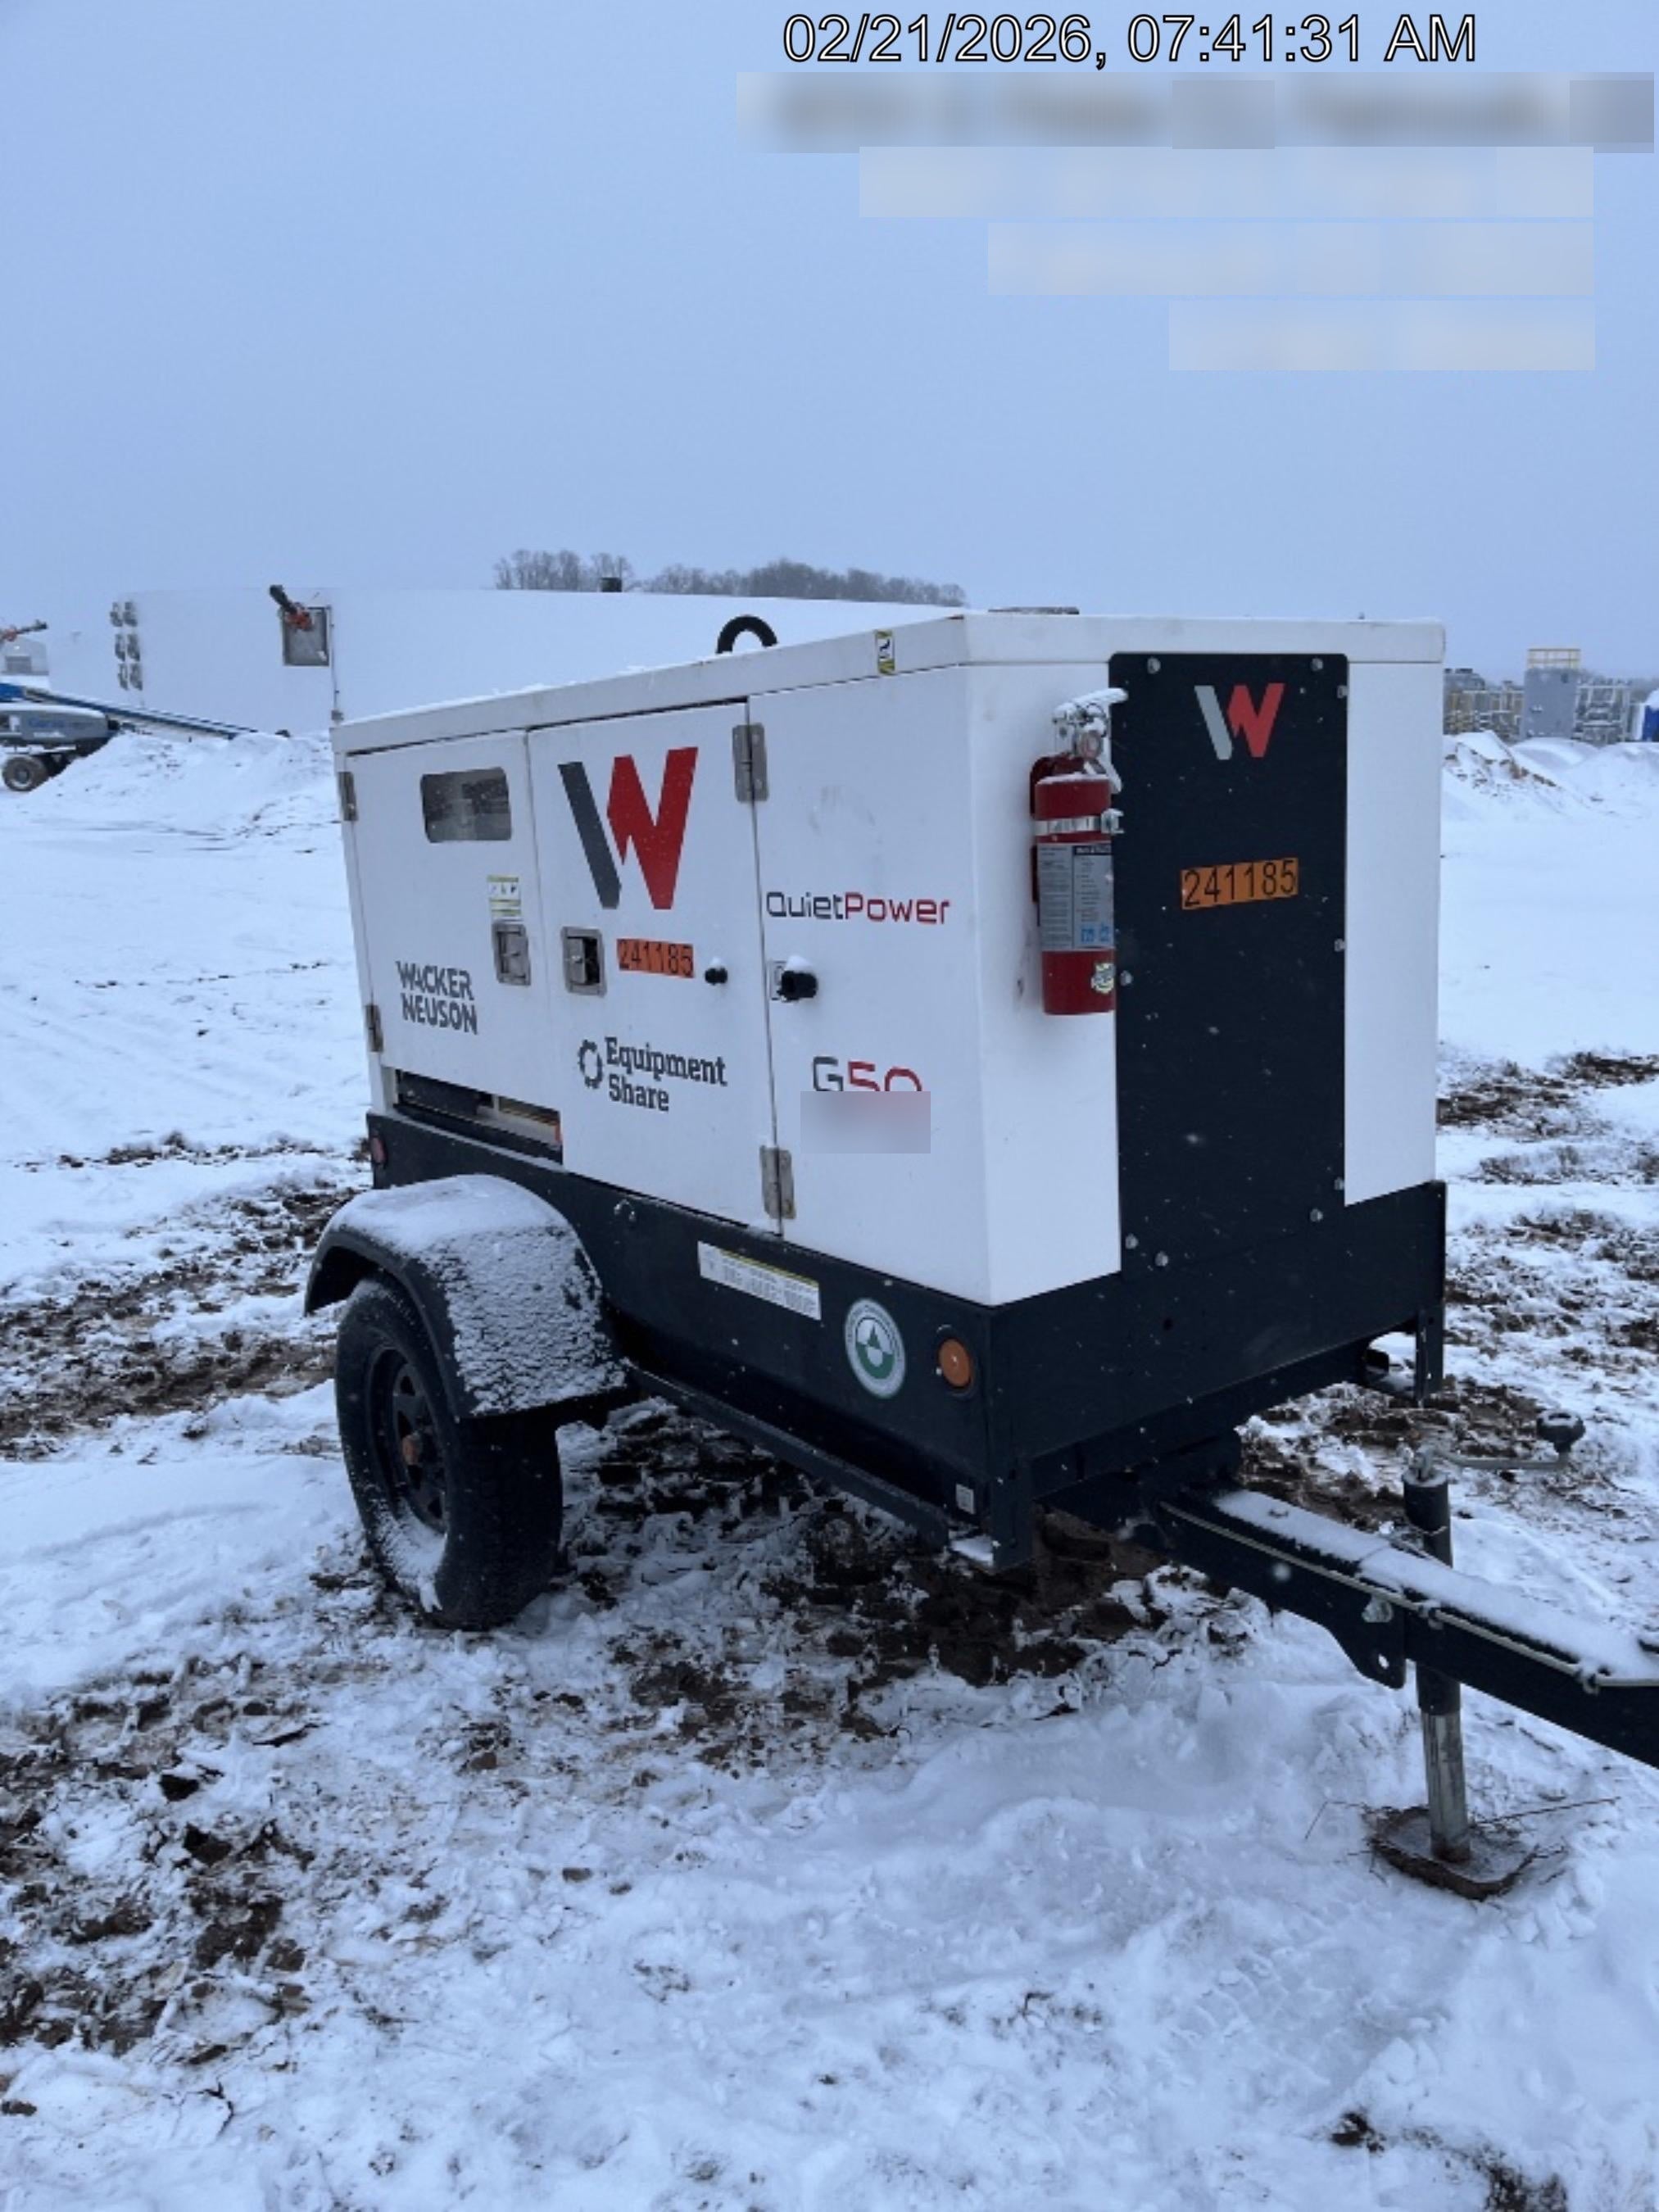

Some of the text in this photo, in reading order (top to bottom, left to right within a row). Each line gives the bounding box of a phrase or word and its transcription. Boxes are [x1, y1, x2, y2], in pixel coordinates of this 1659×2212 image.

[1184, 859, 1297, 906] 241185
[766, 891, 951, 925] QuietPower
[619, 939, 694, 978] 241185
[396, 960, 475, 1001] WACKER
[401, 992, 478, 1036] NEUSON
[604, 1036, 728, 1087] Equipment
[608, 1072, 670, 1113] Share
